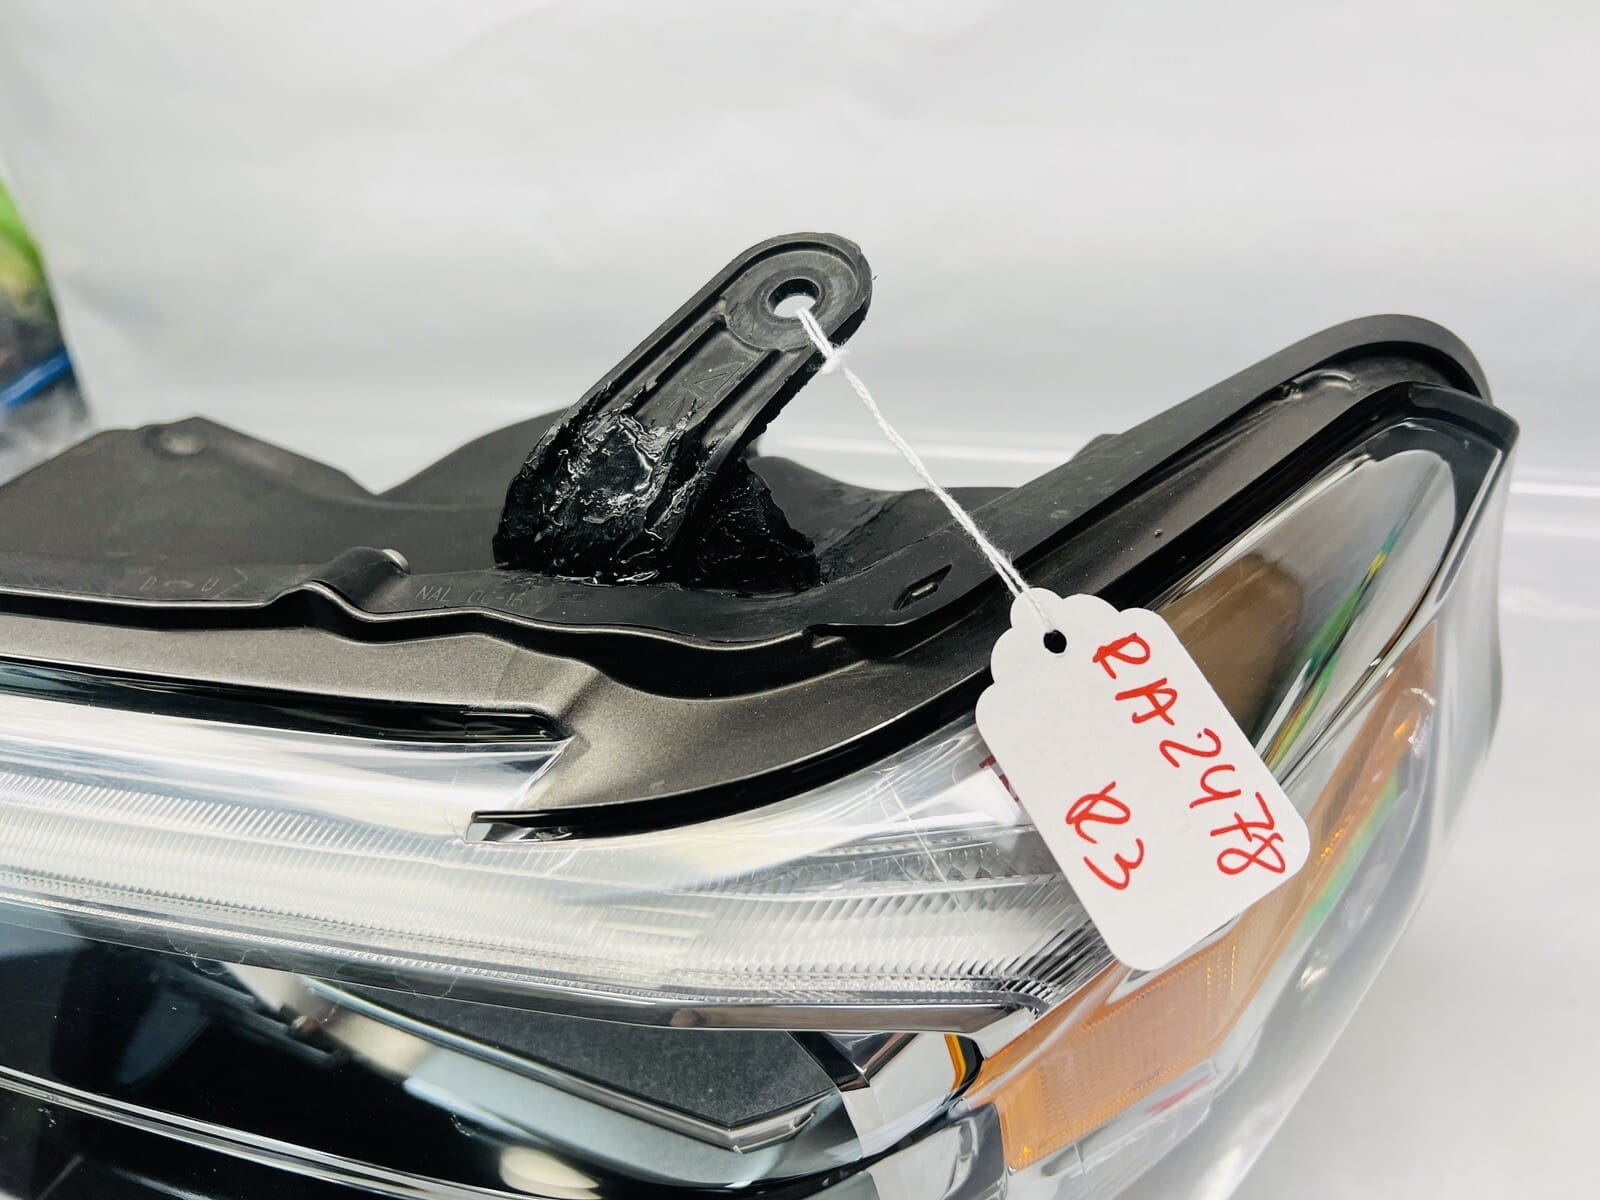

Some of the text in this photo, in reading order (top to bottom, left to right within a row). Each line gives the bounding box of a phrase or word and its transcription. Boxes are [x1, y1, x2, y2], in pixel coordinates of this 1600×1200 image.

[415, 585, 452, 603] NAL
[1093, 632, 1286, 876] RA2478
[1065, 780, 1144, 891] R3
